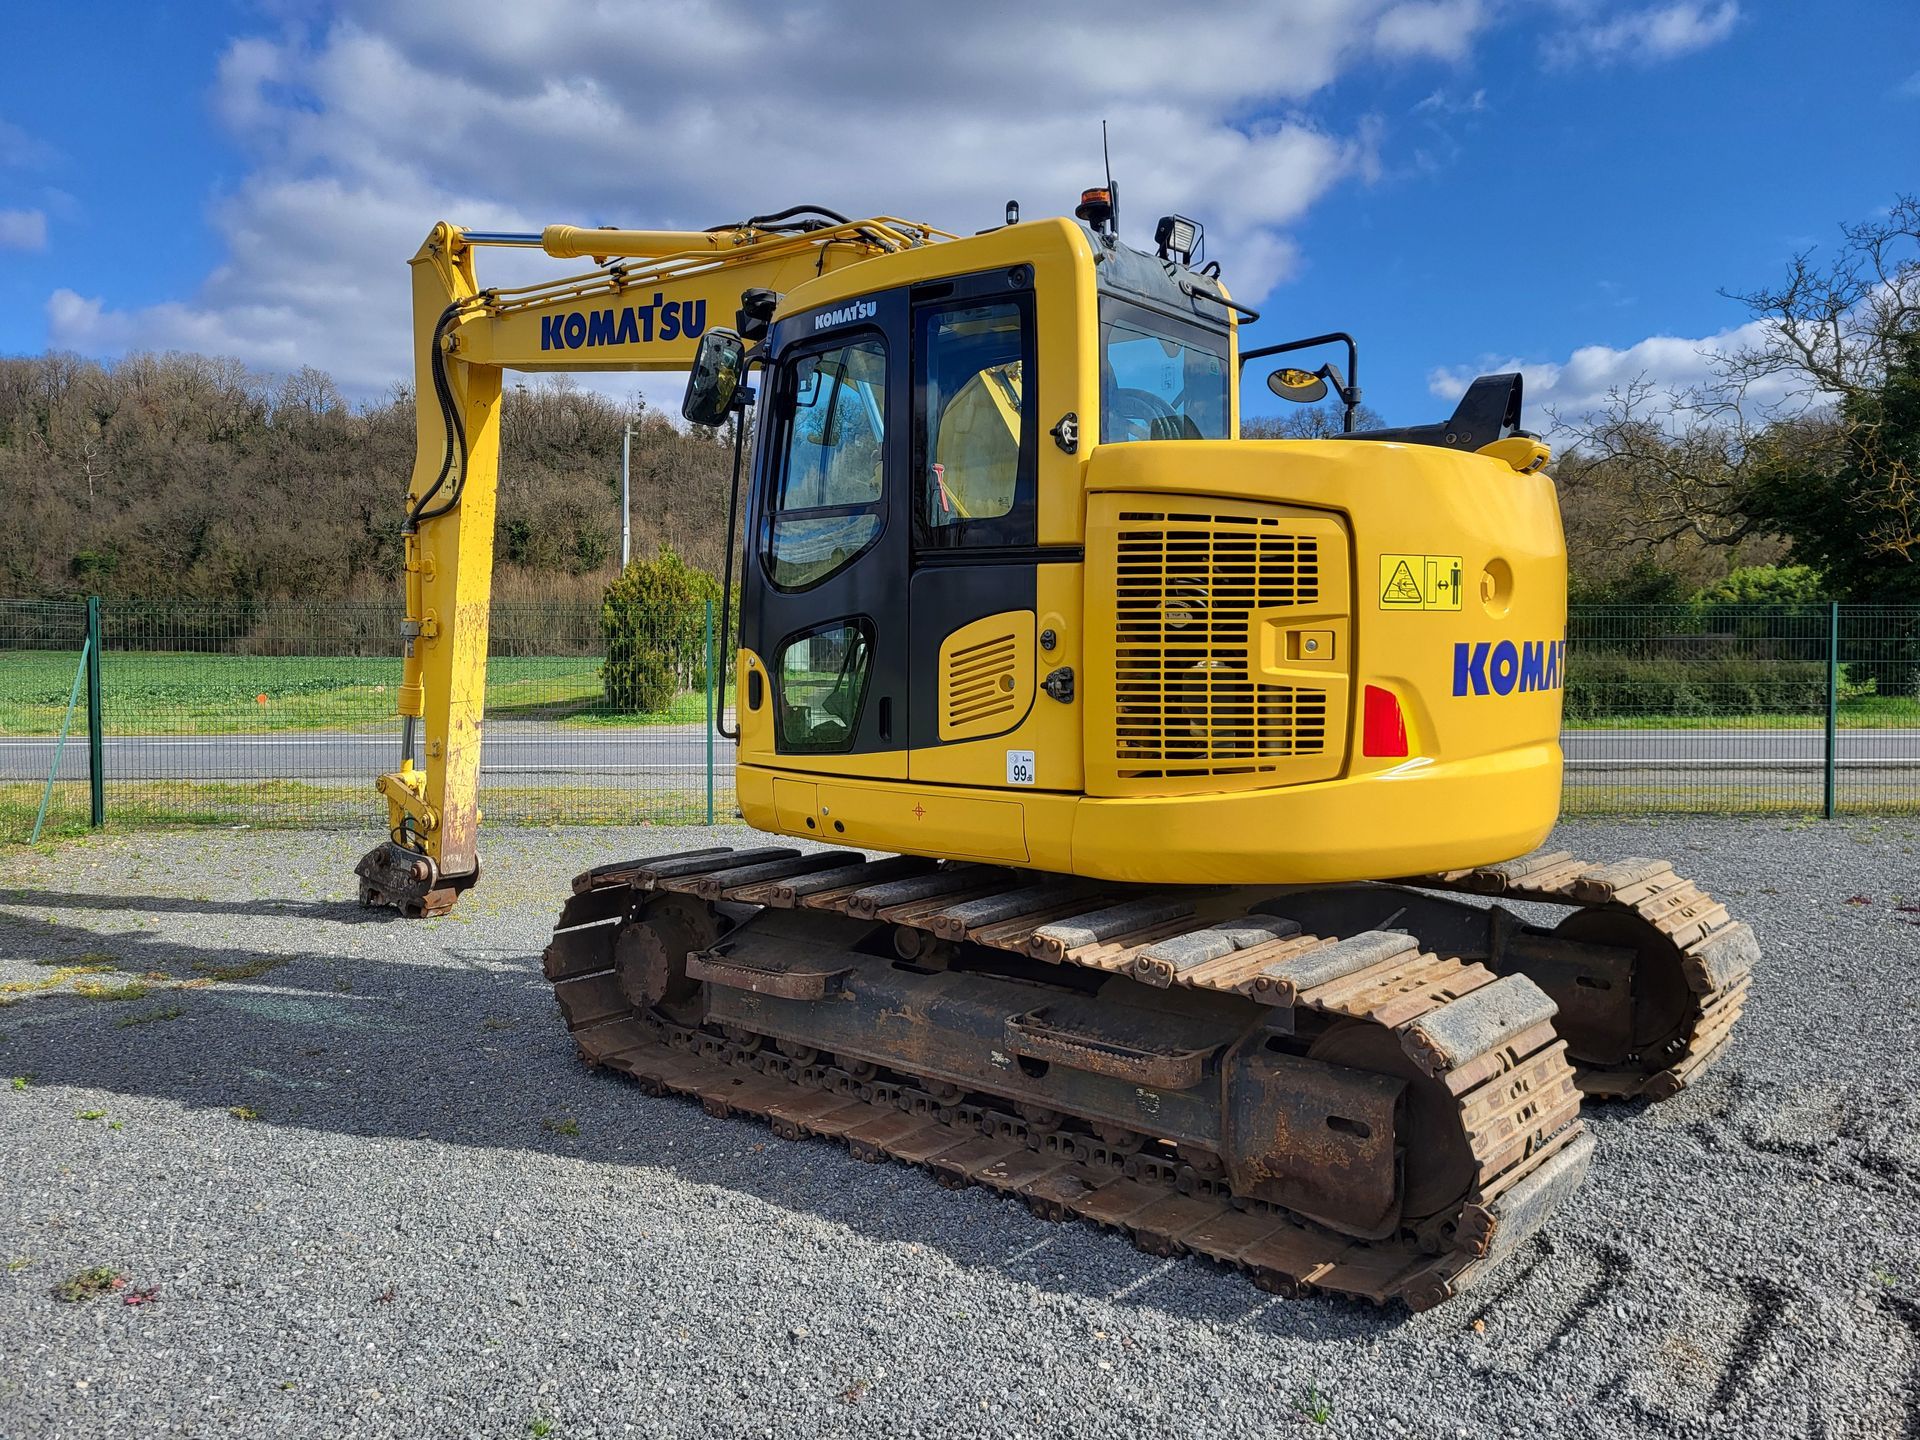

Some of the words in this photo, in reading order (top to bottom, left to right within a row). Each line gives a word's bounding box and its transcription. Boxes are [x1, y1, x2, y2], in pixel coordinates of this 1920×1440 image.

[541, 293, 706, 350] KOMATSU
[815, 301, 877, 329] KOMATSU
[1013, 765, 1027, 781] 99
